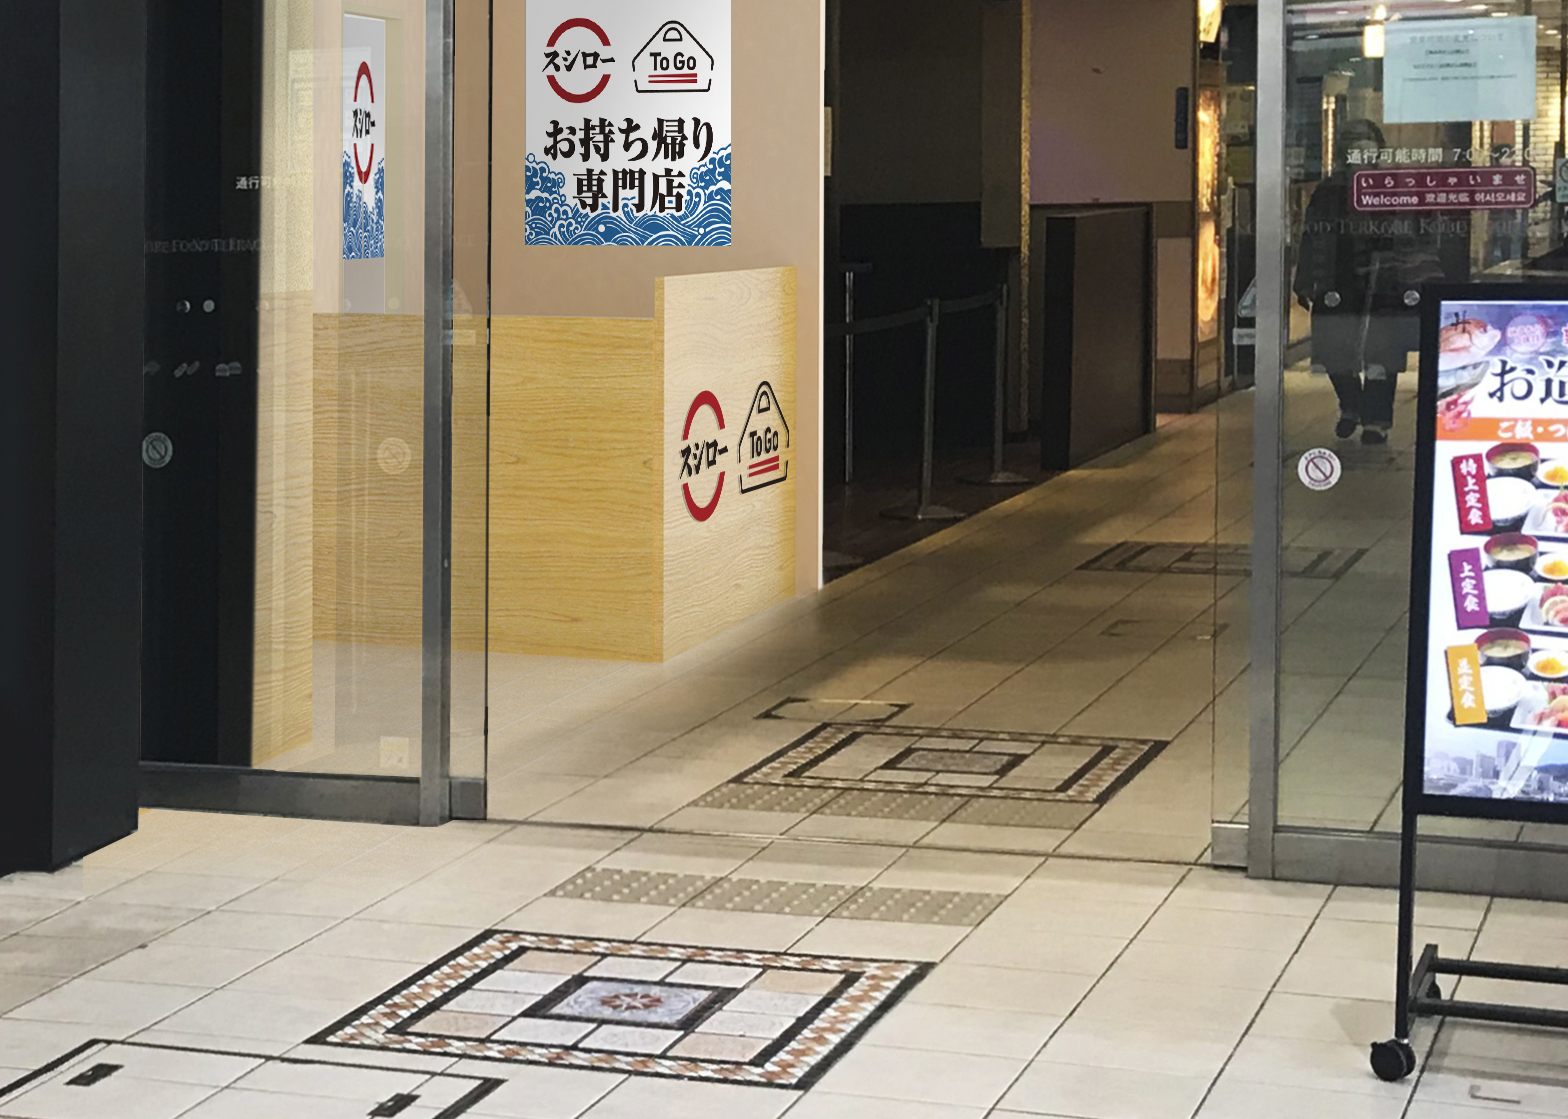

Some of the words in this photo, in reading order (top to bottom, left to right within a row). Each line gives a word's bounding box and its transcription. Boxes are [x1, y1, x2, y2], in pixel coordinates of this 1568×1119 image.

[541, 49, 616, 73] スシロー
[351, 107, 376, 139] スシロー
[543, 116, 714, 163] お持ち帰り
[1346, 147, 1443, 165] 通行可能時間
[572, 167, 687, 214] 専門店
[1361, 173, 1527, 187] いらっしゃいませ
[1361, 194, 1420, 206] Welcome
[678, 438, 729, 480] スシロー
[1460, 458, 1484, 525] 特上定食
[1459, 561, 1480, 613] 上定食
